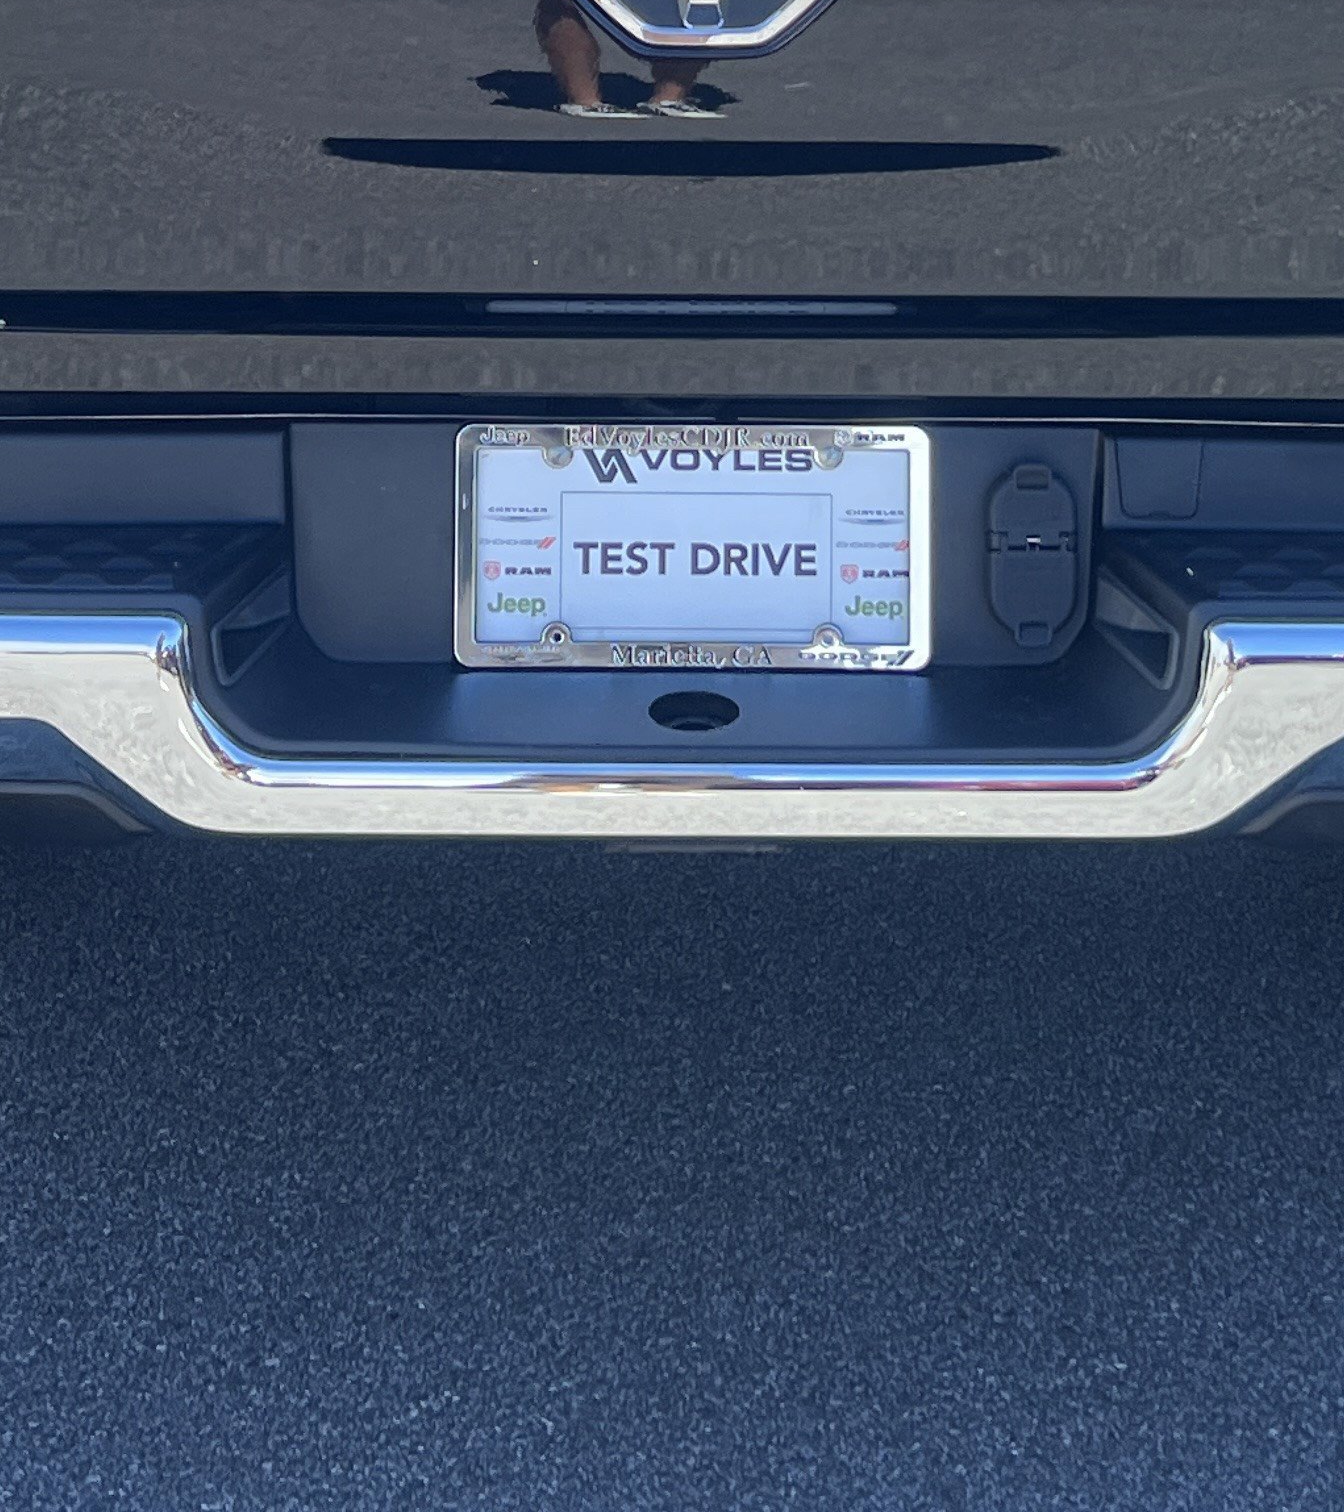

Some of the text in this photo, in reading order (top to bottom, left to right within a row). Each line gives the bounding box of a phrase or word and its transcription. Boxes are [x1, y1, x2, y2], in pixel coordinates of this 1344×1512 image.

[478, 426, 531, 446] Jeep
[640, 448, 813, 472] VOYLES
[572, 541, 818, 577] TEST DRIVE
[504, 566, 552, 576] RAM
[862, 569, 910, 578] RAM
[487, 591, 546, 617] Jeep
[844, 595, 903, 620] Jeep
[732, 645, 773, 668] GA
